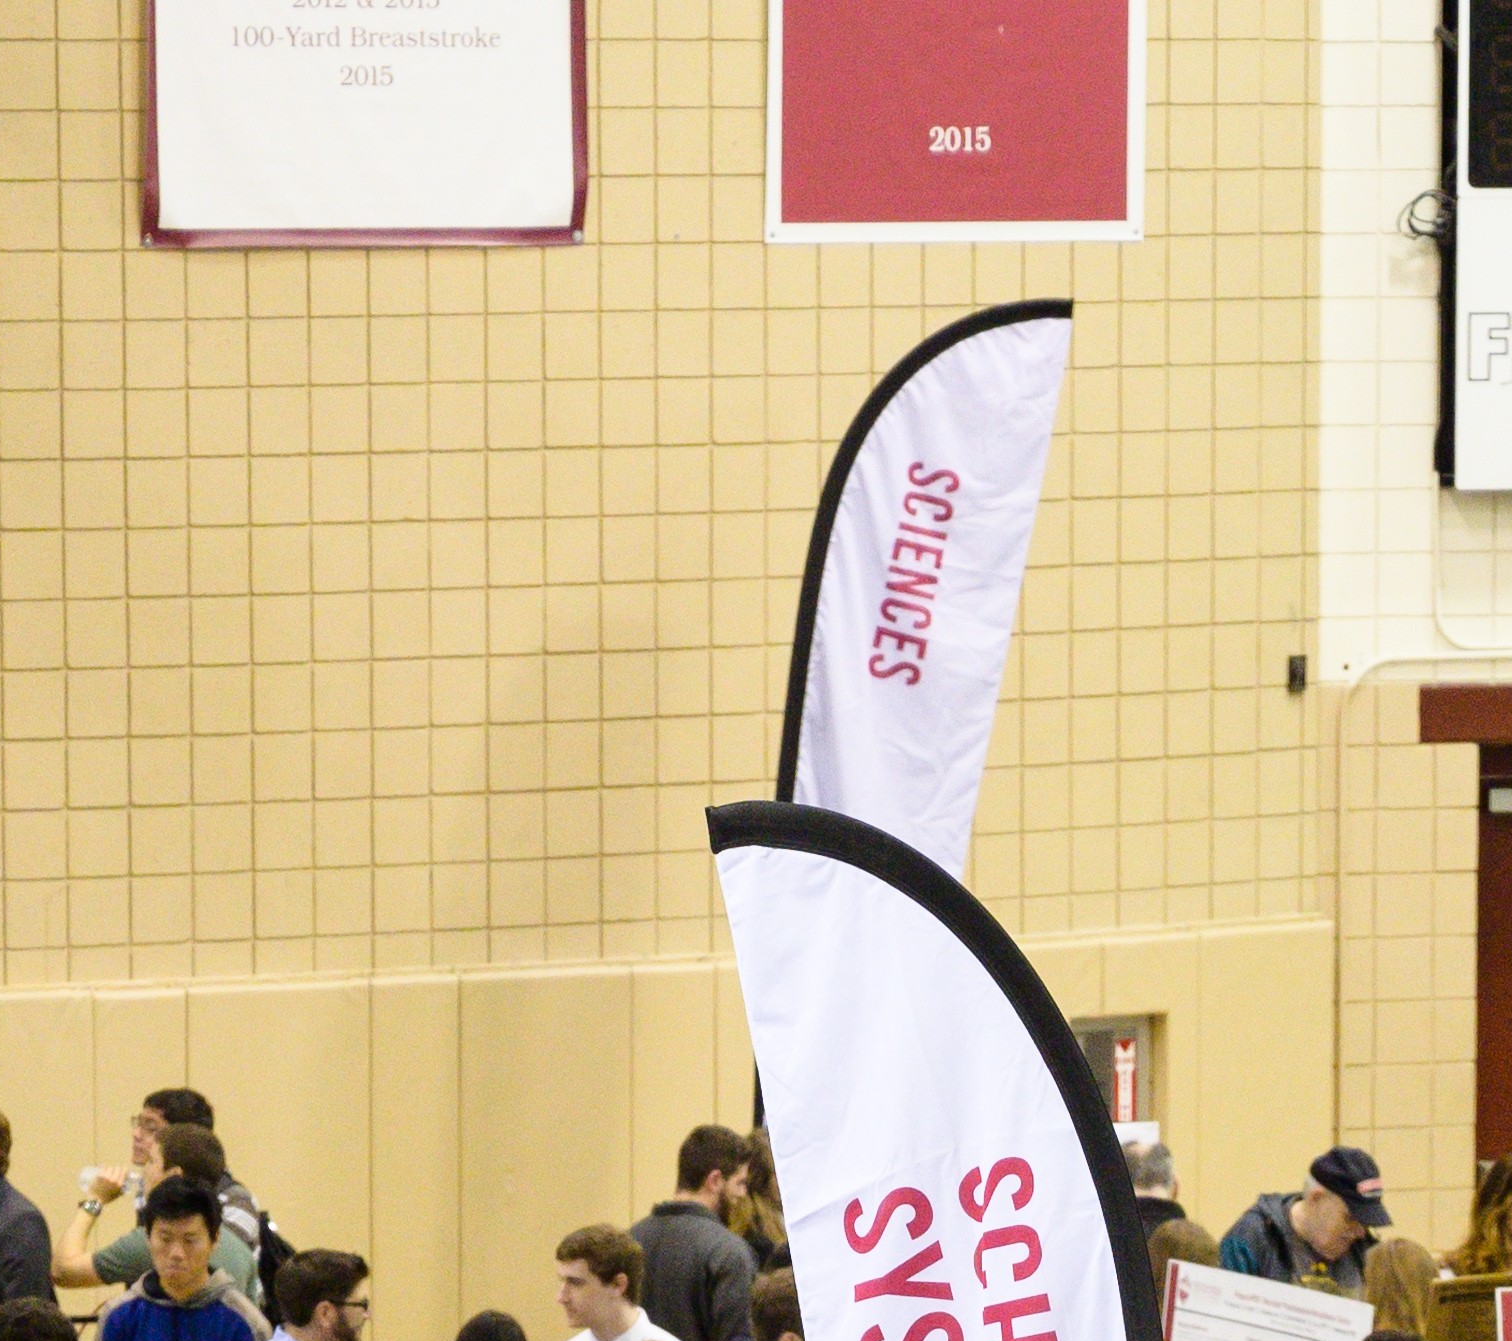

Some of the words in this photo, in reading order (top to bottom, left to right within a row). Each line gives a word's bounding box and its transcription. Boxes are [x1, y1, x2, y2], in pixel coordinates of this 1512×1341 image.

[233, 26, 340, 47] 100-Yard
[351, 27, 500, 48] Breaststroke
[341, 66, 393, 86] 2015
[929, 126, 991, 152] 2015
[869, 461, 959, 688] SCIENCES
